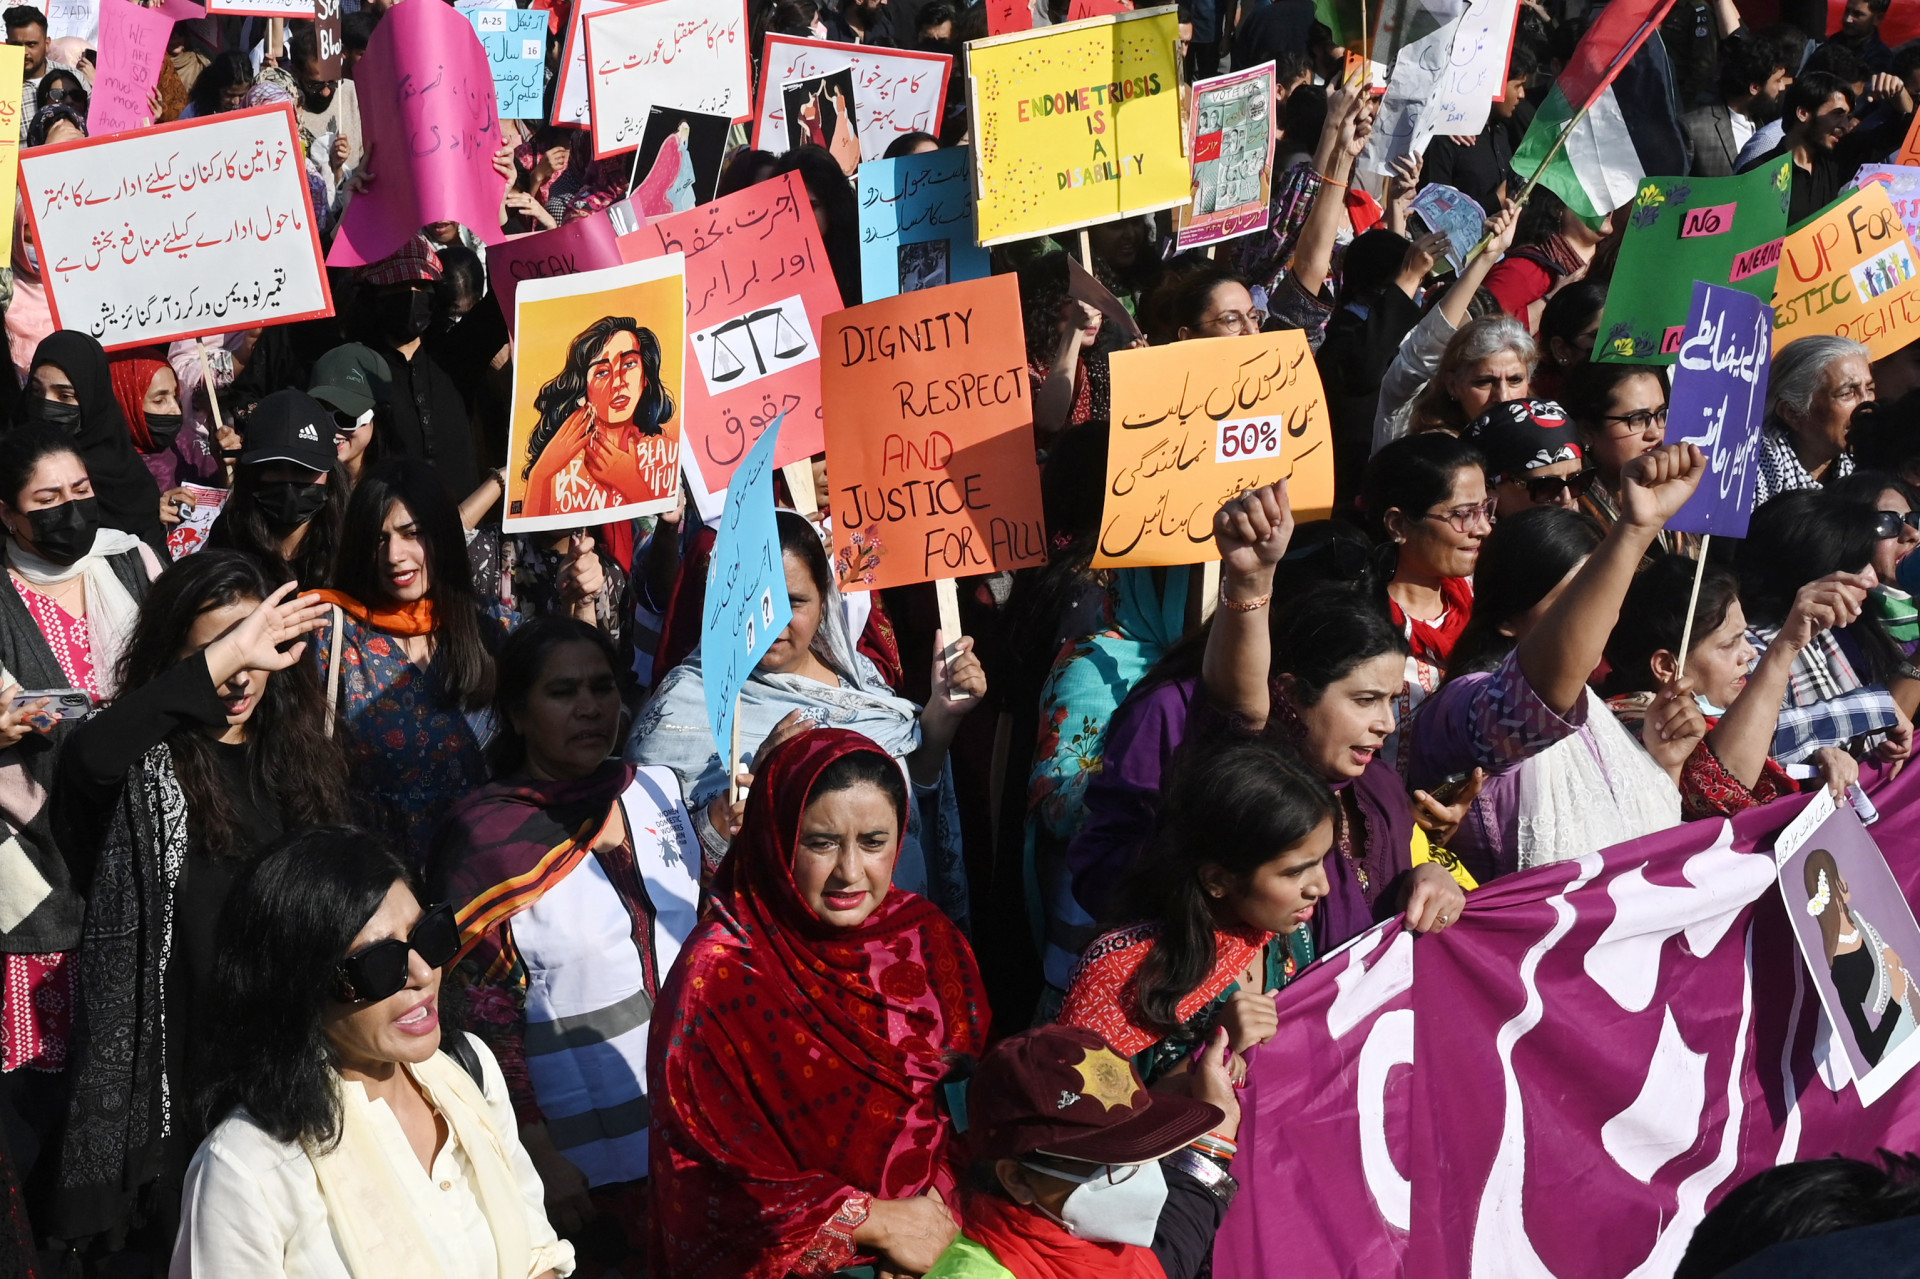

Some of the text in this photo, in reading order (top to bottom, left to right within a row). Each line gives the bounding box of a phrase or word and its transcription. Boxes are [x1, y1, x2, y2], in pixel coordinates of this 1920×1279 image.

[481, 17, 503, 26] A-25
[707, 22, 718, 49] کا
[716, 17, 739, 59] کام
[493, 35, 520, 62] سال
[527, 46, 539, 55] 16
[623, 38, 664, 69] عورت
[663, 18, 707, 64] مستقبل
[493, 62, 543, 88] کی مفت
[598, 60, 620, 85] ہے
[782, 52, 807, 79] کو
[503, 83, 518, 111] کو
[517, 86, 541, 117] تعلیم
[876, 78, 892, 101] پر
[892, 72, 928, 102] کام
[1017, 72, 1161, 123] ENDOMETRIOSIS
[1211, 80, 1261, 103] VOTE FOR
[860, 109, 896, 133] بہتر
[1086, 110, 1106, 135] IS
[1446, 113, 1465, 122] DAY
[1092, 138, 1107, 161] A
[42, 140, 287, 220] خواتین کارکنان کیلئے ادارے کا بہتر
[1056, 153, 1144, 190] DISABILITY
[55, 205, 301, 282] ماحول ادارے کیلئے منافع بخش ہے
[771, 237, 815, 281] اور
[1736, 242, 1783, 278] MEANS
[1786, 223, 1839, 283] UP
[1847, 205, 1902, 254] FOR
[175, 286, 211, 320] ورکرز
[260, 268, 287, 310] تعمیر
[1773, 274, 1851, 329] ESTIC
[91, 295, 172, 338] آرگنائزیشن
[1835, 289, 1920, 344] RIGHTS
[838, 308, 973, 368] DIGNITY
[892, 366, 1024, 420] RESPECT
[1121, 371, 1204, 430] سیاست
[1204, 350, 1269, 421] کی
[1287, 398, 1318, 438] میں
[298, 433, 319, 441] adidas
[637, 438, 679, 469] BEAU
[882, 430, 953, 477] AND
[1221, 421, 1277, 457] 50%
[555, 460, 591, 502] BR
[561, 484, 608, 513] OWN
[640, 464, 679, 497] TIFUL
[841, 473, 991, 529] JUSTICE
[1100, 489, 1188, 557] بنائیں
[924, 526, 987, 576] FOR
[657, 807, 680, 818] WOMEN
